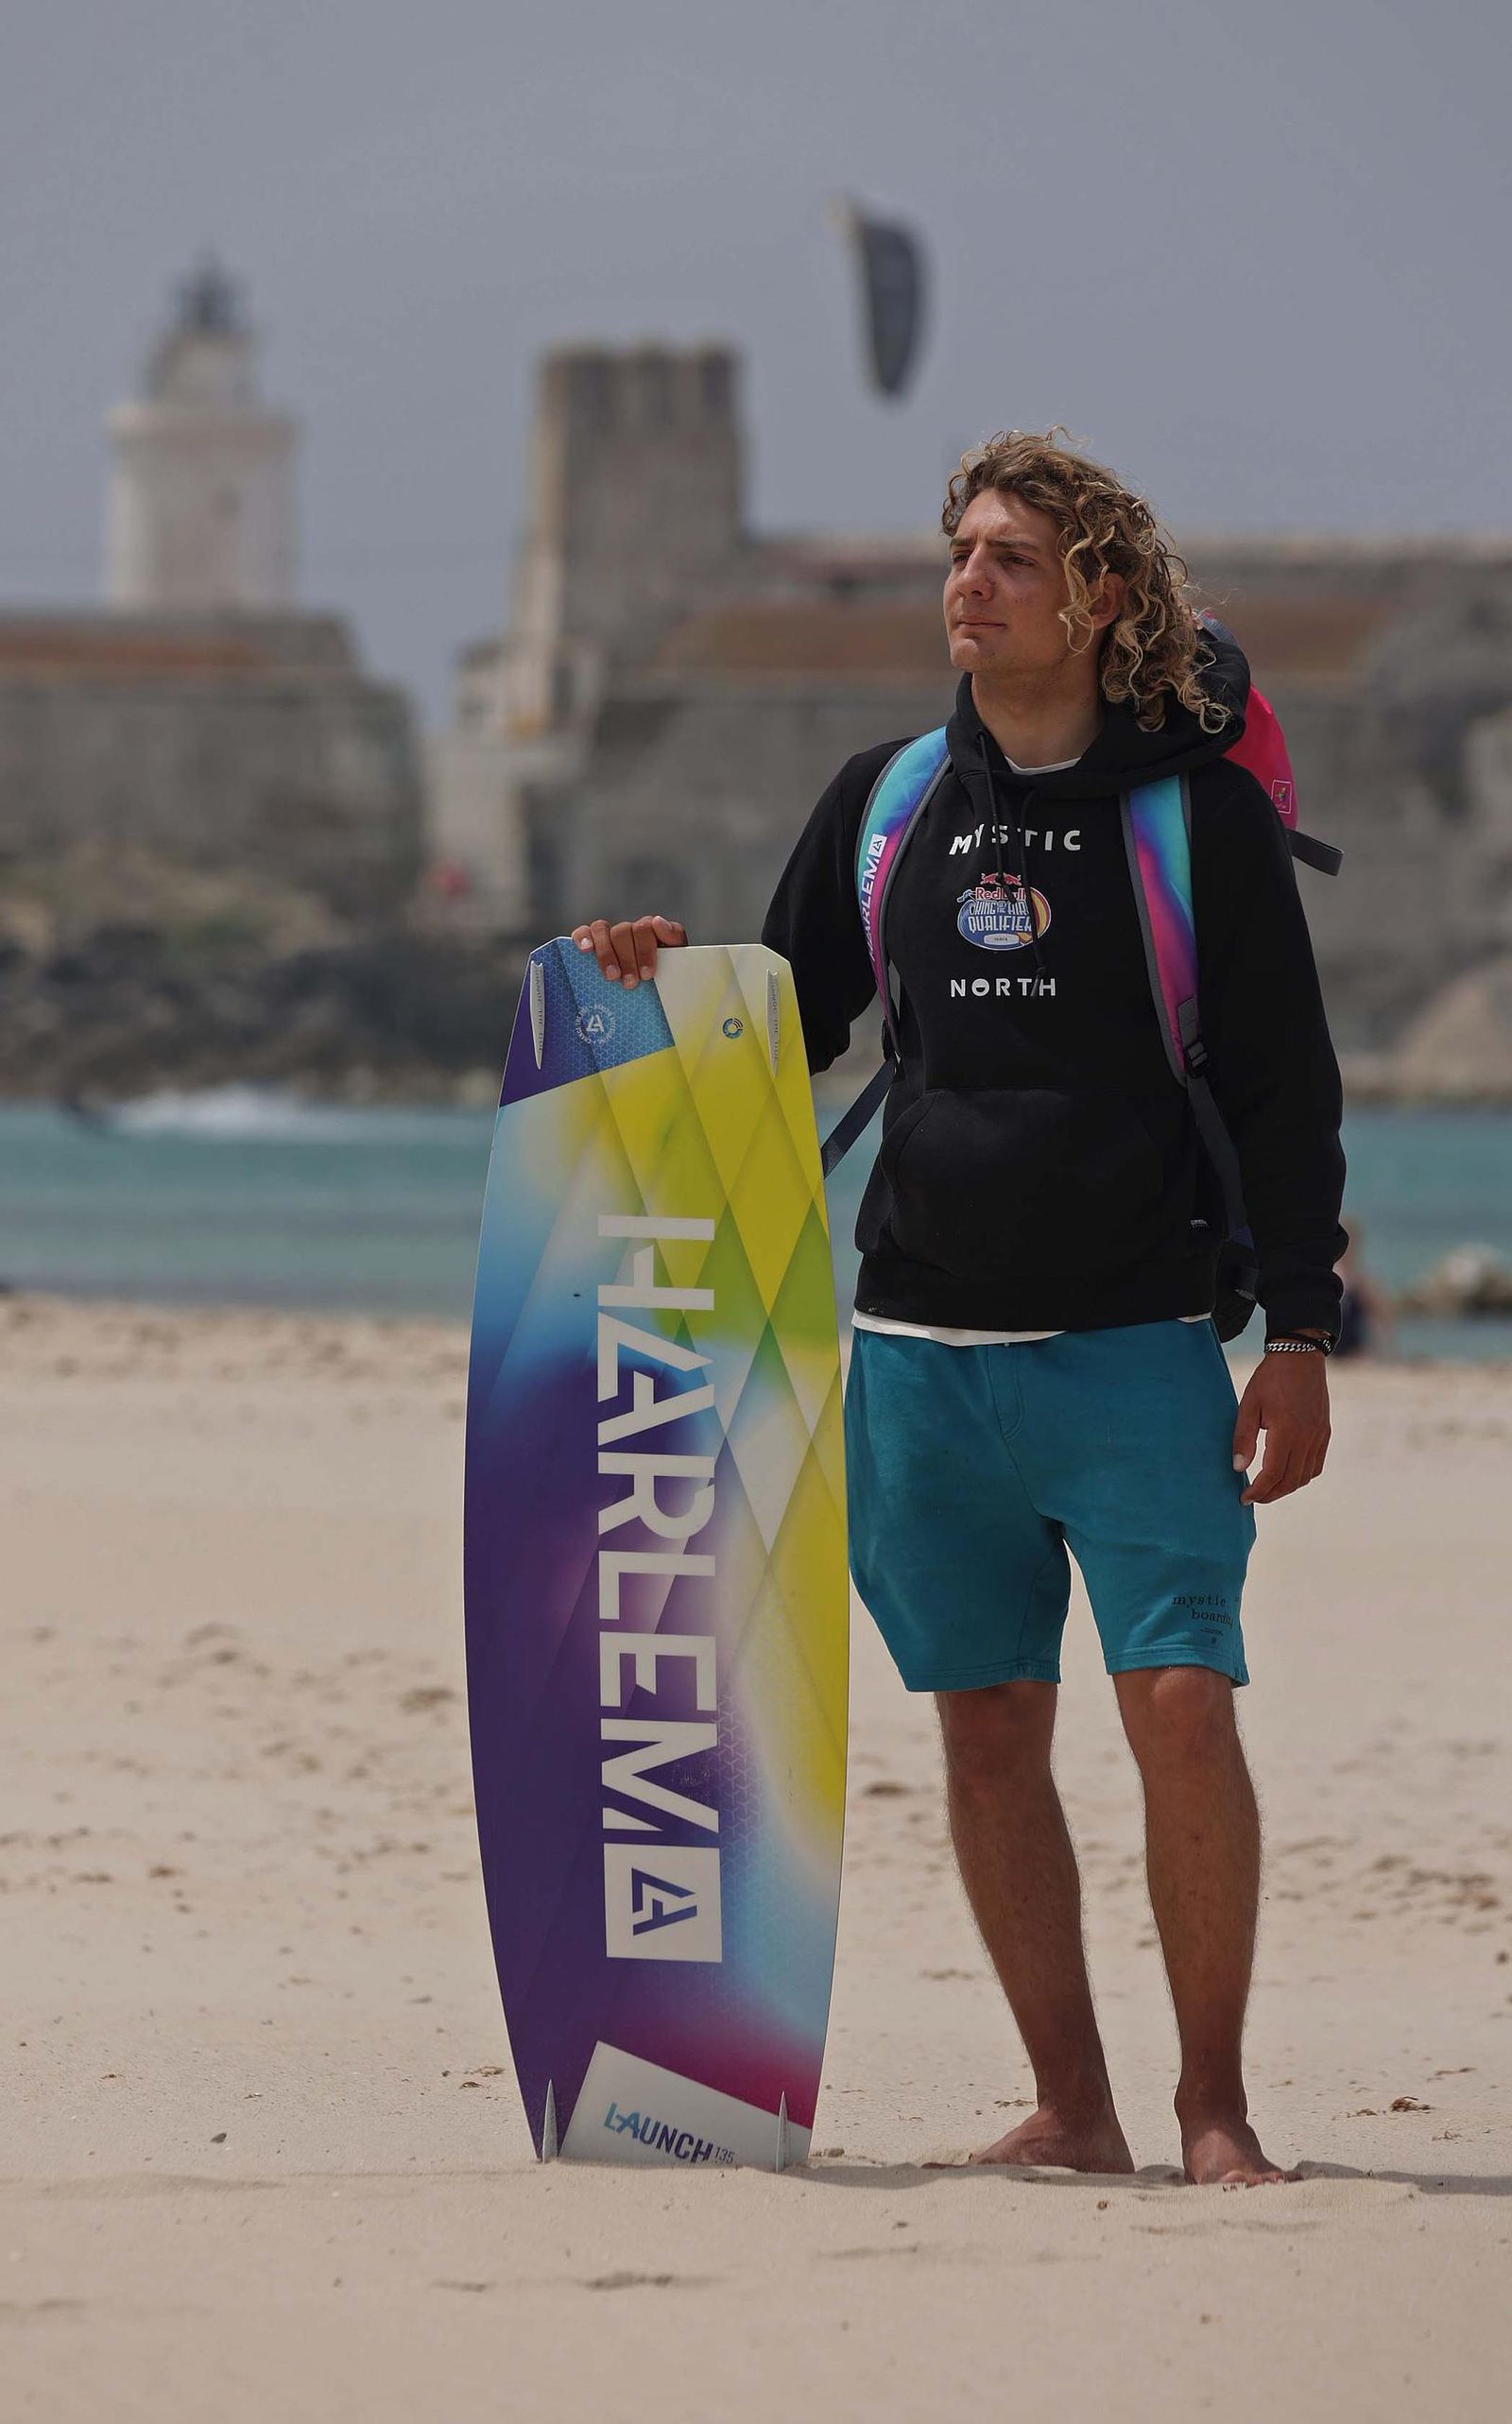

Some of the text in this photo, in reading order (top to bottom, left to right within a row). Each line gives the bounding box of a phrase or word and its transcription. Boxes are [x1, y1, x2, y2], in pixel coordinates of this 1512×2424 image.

[948, 823, 1081, 855] MYSTIC
[974, 886, 999, 900] Red
[950, 977, 1057, 998] NORTH
[1172, 1594, 1227, 1608] mystic
[603, 2101, 735, 2164] LAUNCH 135
